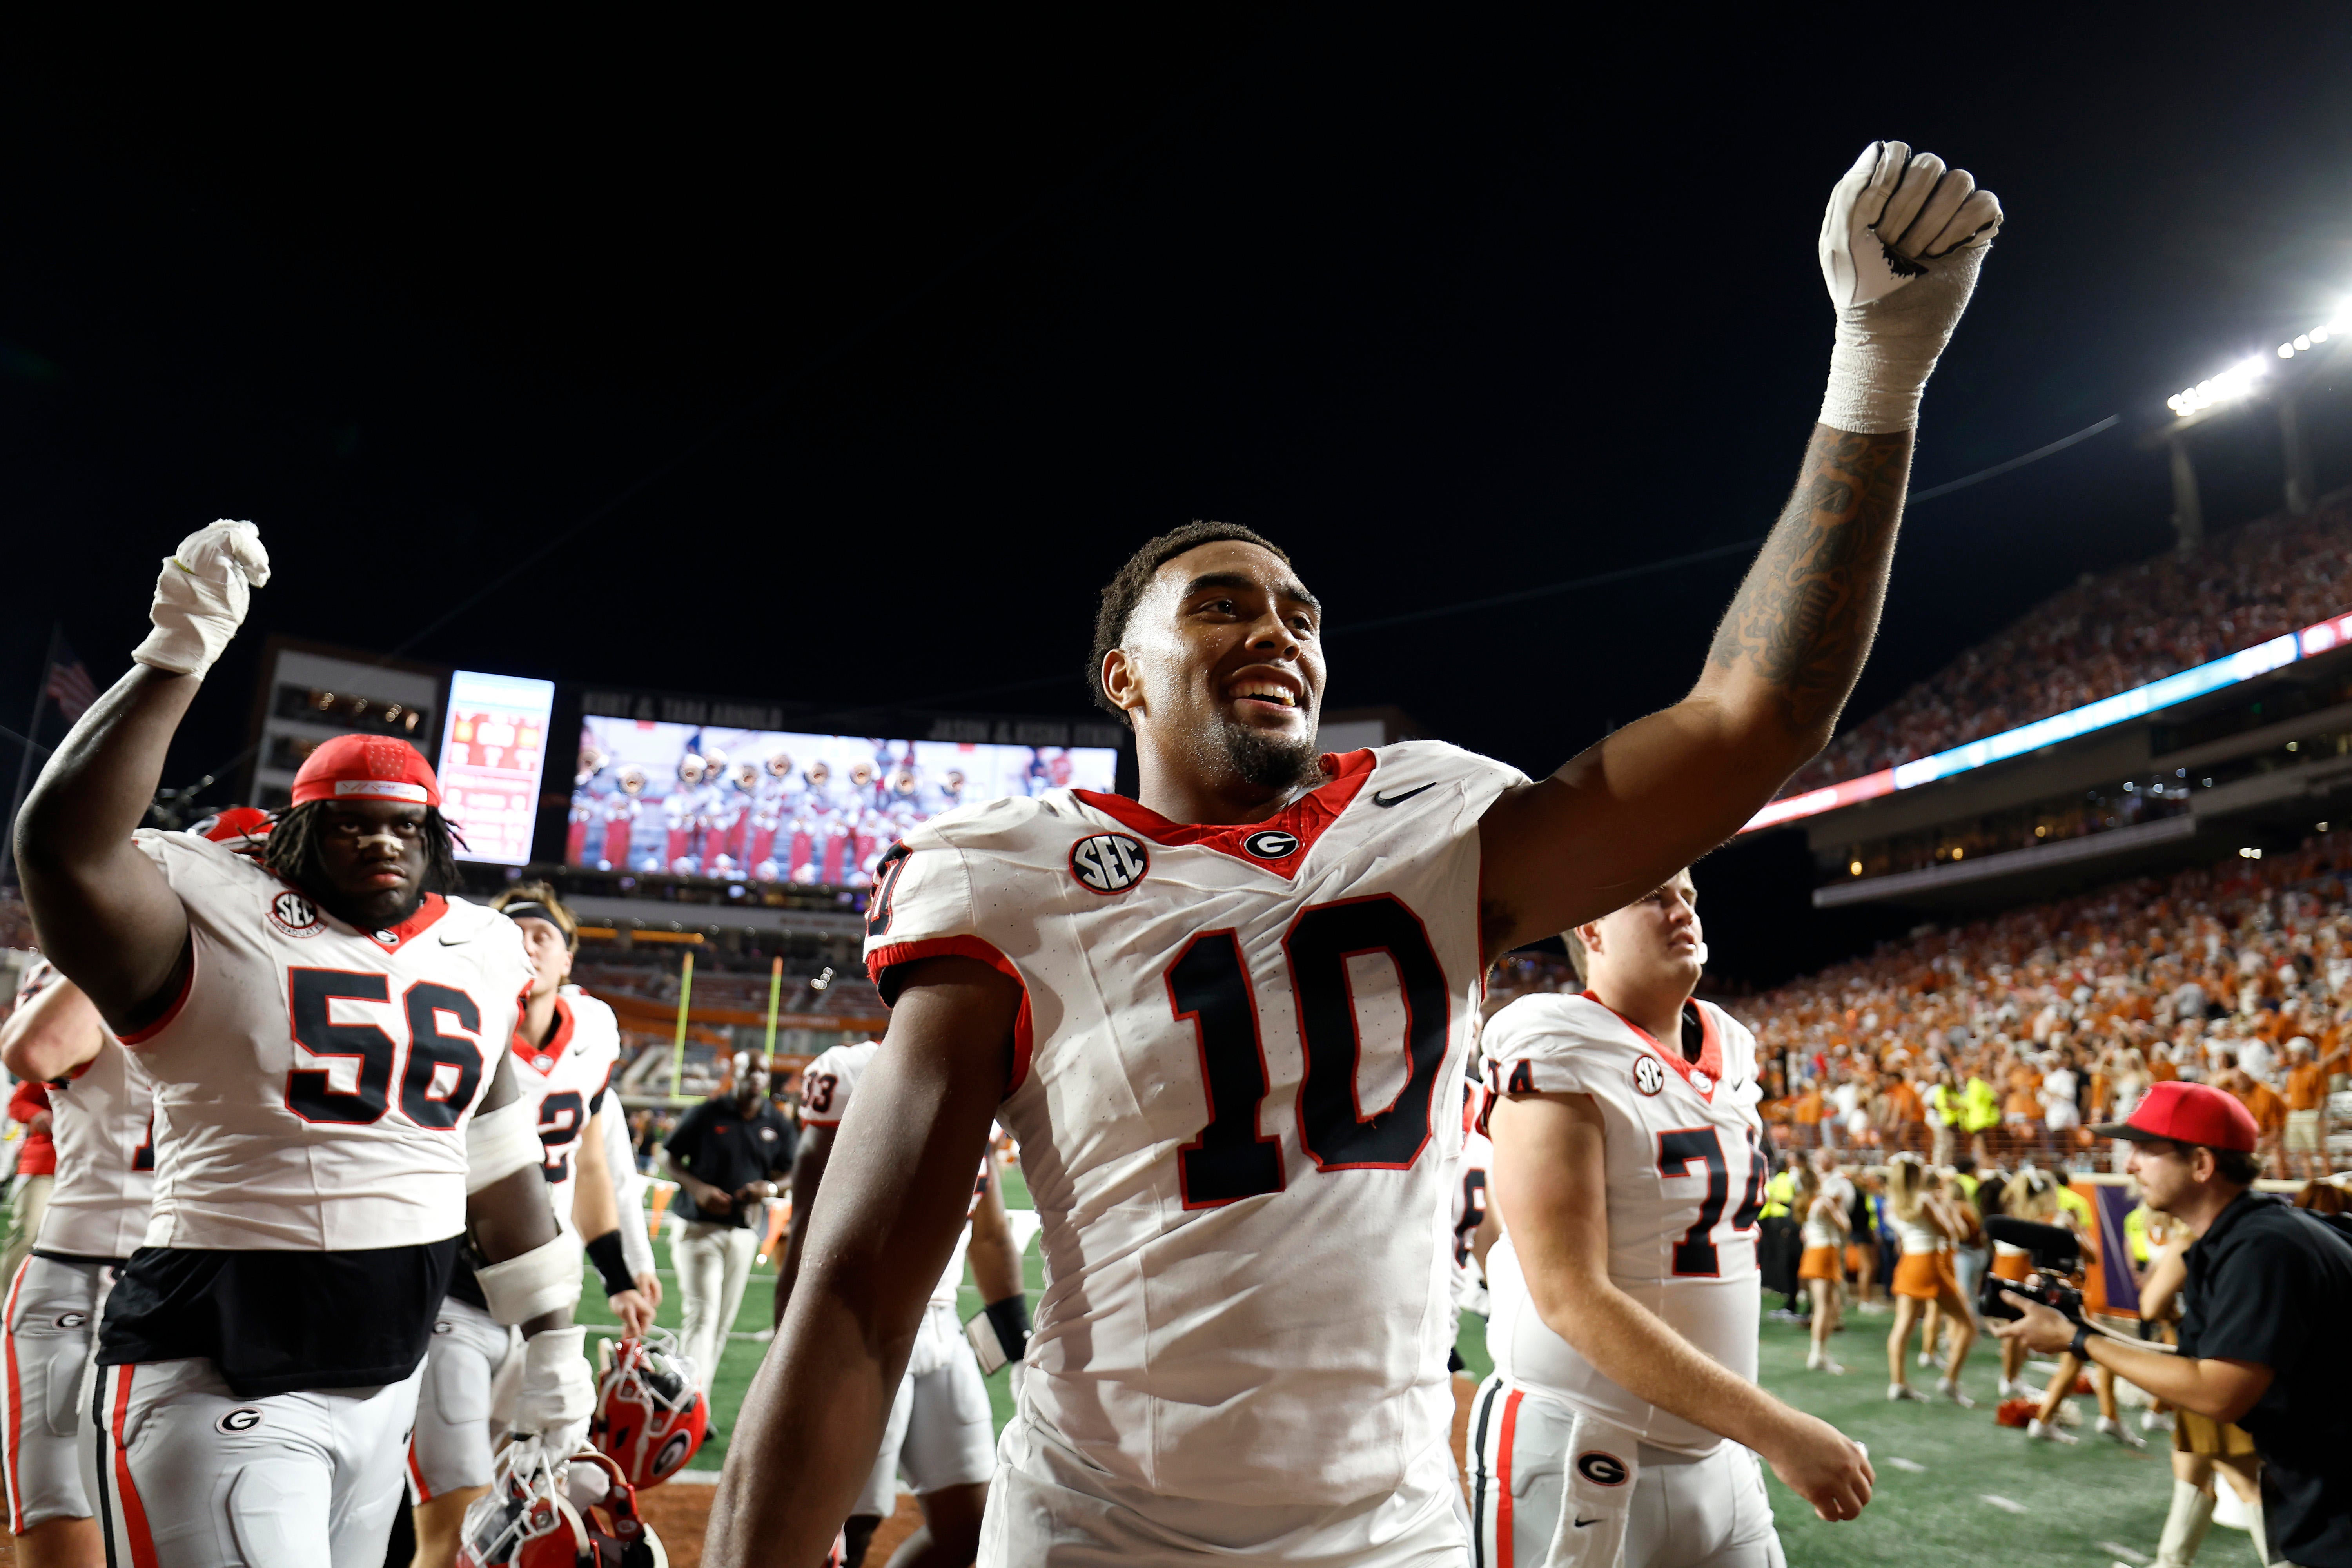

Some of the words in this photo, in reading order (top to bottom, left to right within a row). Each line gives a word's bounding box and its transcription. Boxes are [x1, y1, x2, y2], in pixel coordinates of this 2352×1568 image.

[1075, 835, 1144, 889] SEC
[276, 893, 314, 926] SEC
[285, 966, 483, 1131] 56
[1163, 893, 1451, 1210] 10
[1635, 1056, 1663, 1094] SEC
